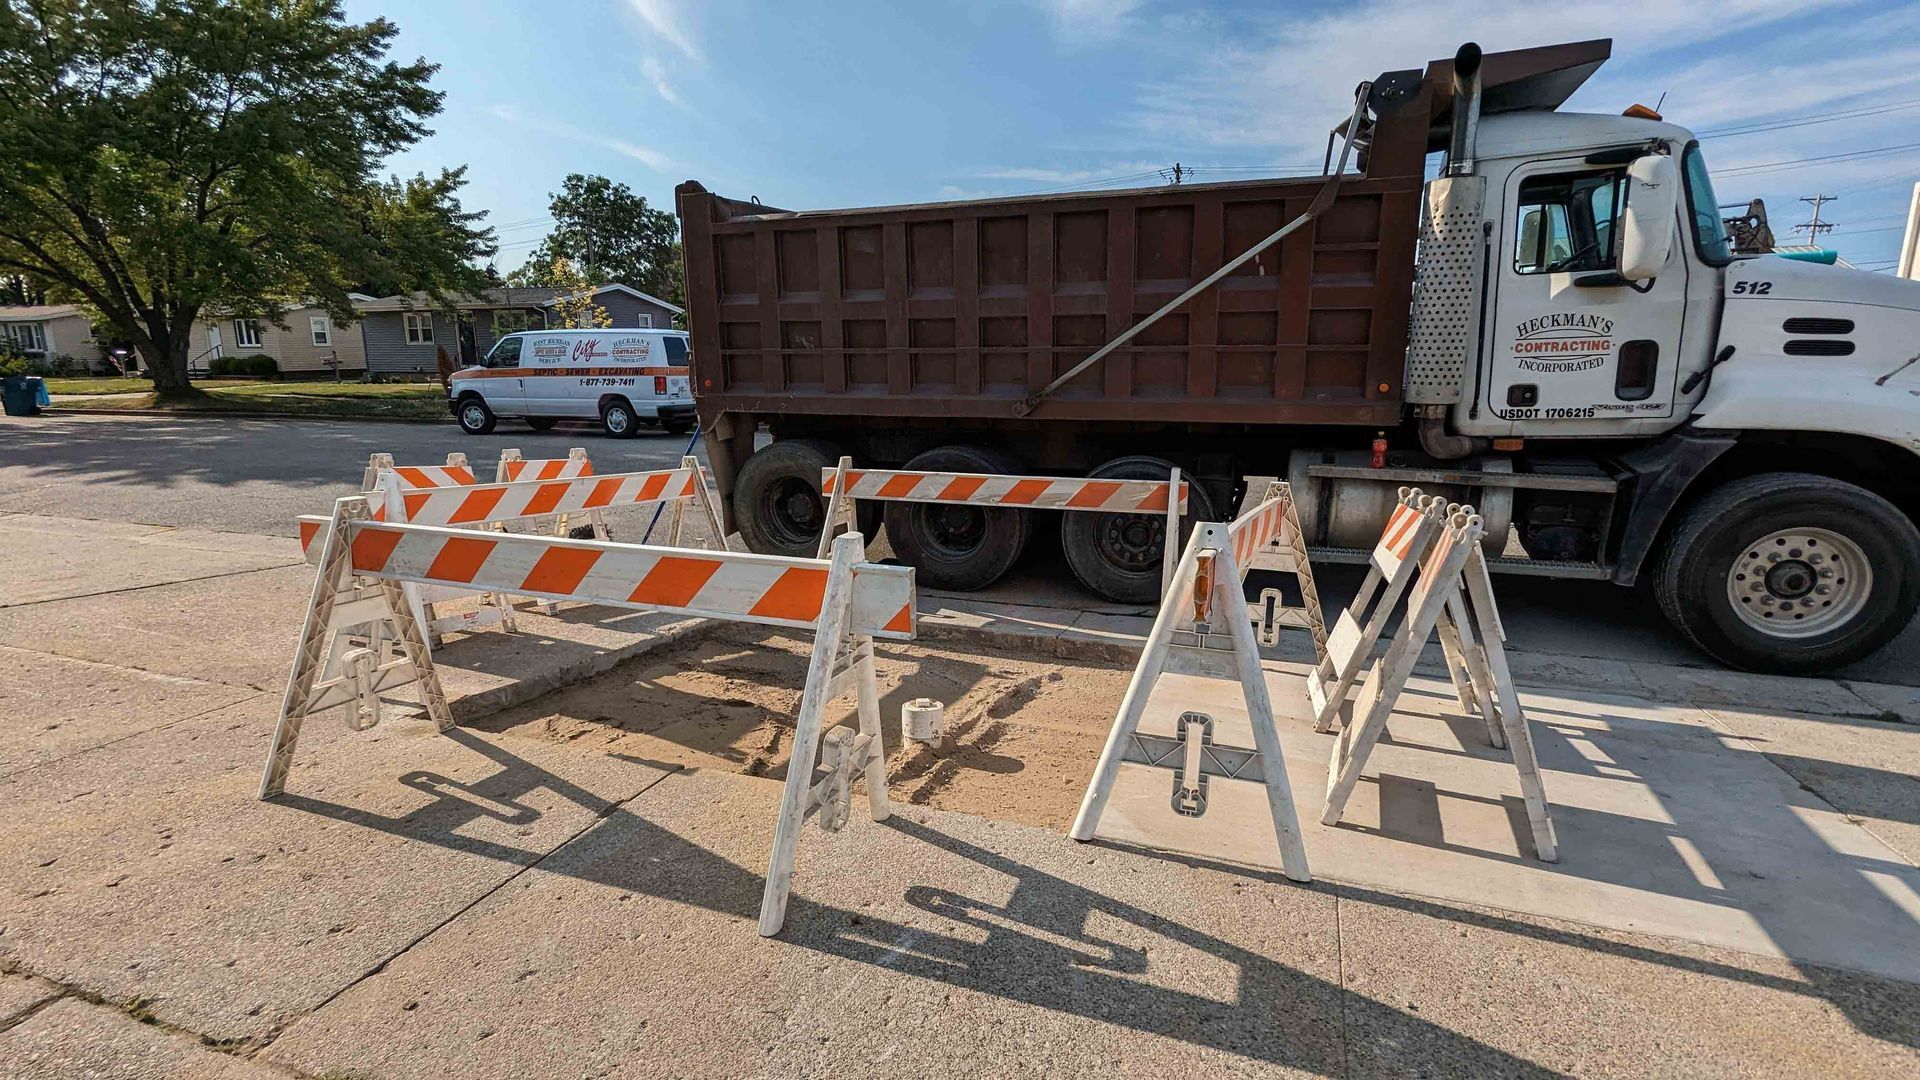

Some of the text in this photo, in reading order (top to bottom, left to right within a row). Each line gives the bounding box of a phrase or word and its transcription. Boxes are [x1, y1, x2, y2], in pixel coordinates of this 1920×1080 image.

[1732, 281, 1773, 295] 512
[1516, 313, 1614, 337] HECKMAN'S
[612, 337, 651, 348] HECKMAN'S
[1514, 340, 1611, 353] CONTRACTING
[572, 339, 602, 362] City
[533, 367, 645, 376] SEPTIC SEWER EXCAVATING
[1518, 357, 1604, 373] INCORPORATED
[579, 378, 635, 386] 1-877-739-7411
[1500, 408, 1540, 419] USDOT
[1544, 407, 1595, 418] 1706215
